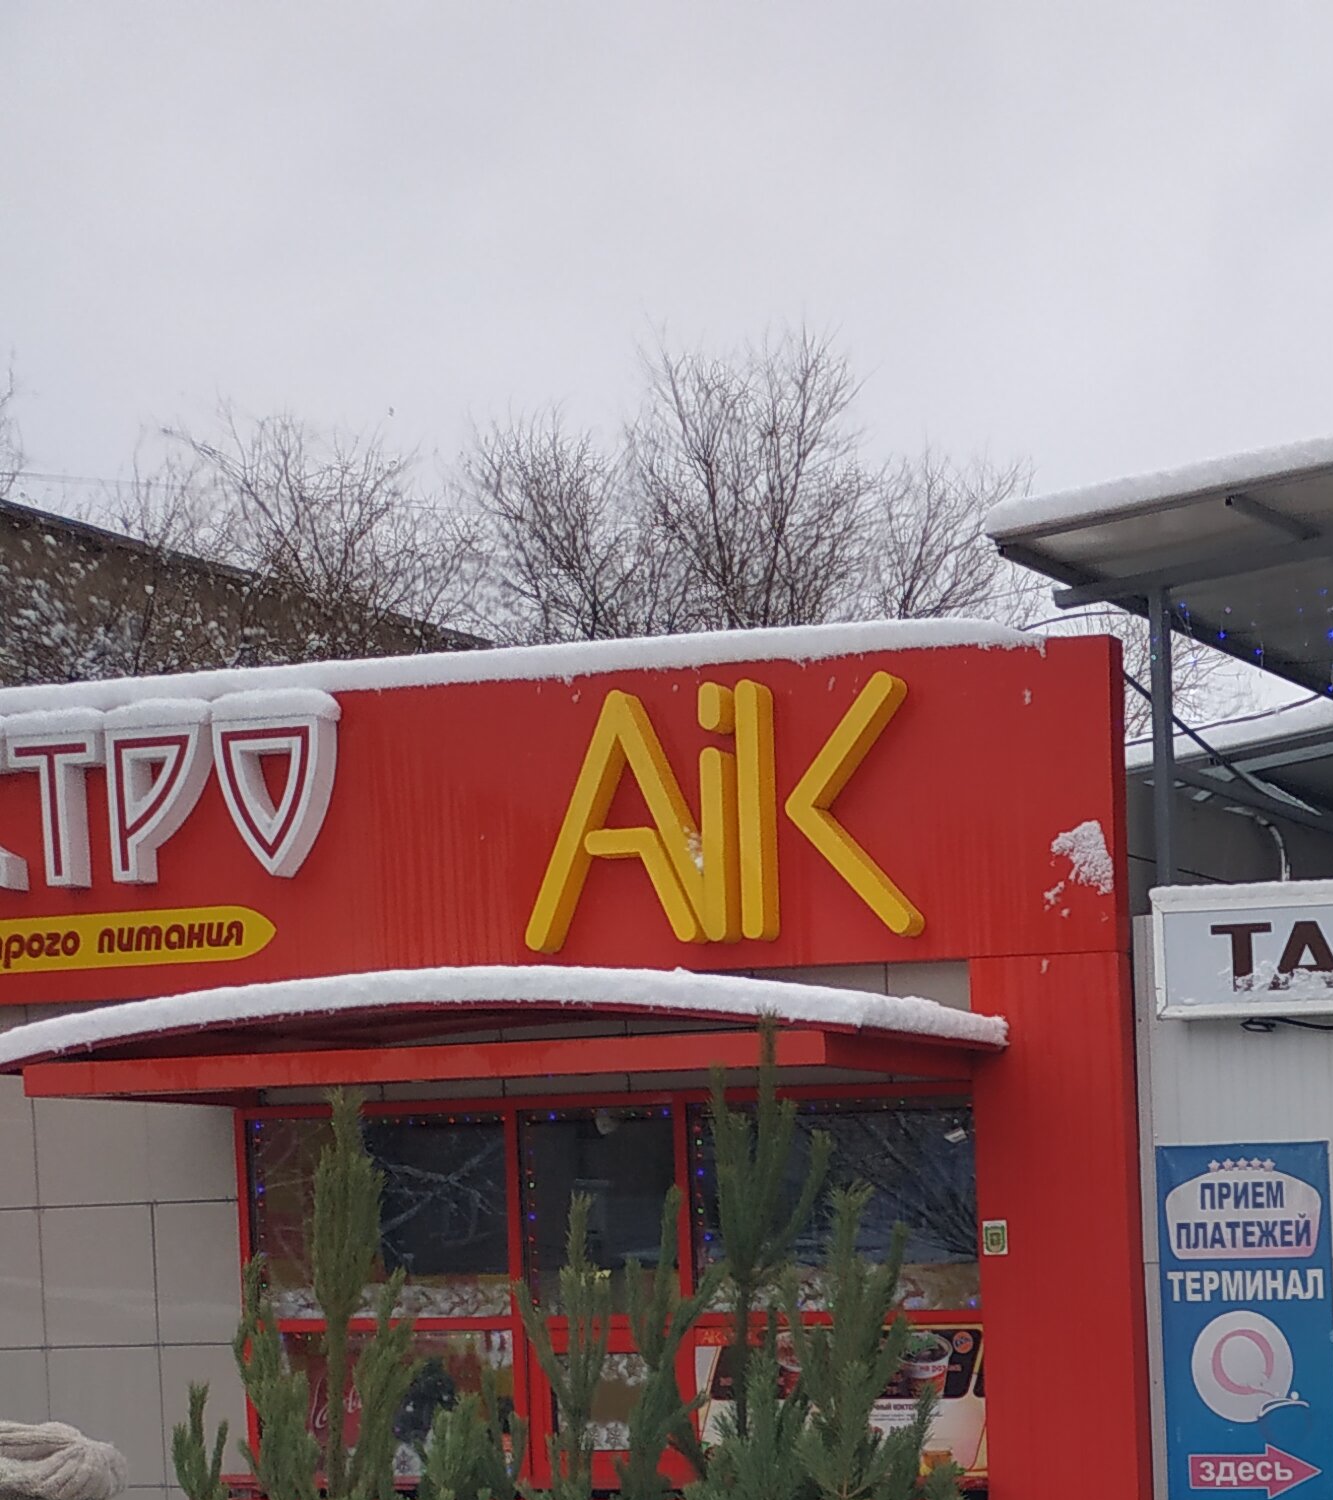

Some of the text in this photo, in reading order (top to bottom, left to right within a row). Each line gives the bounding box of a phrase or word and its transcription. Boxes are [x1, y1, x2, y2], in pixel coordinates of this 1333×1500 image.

[0, 711, 338, 890] ТРО
[97, 920, 244, 954] питания
[1200, 1180, 1285, 1211] ПРИЕМ
[1175, 1212, 1312, 1251] ПЛАТЕЖЕЙ
[1166, 1268, 1325, 1303] ТЕРМИНАЛ
